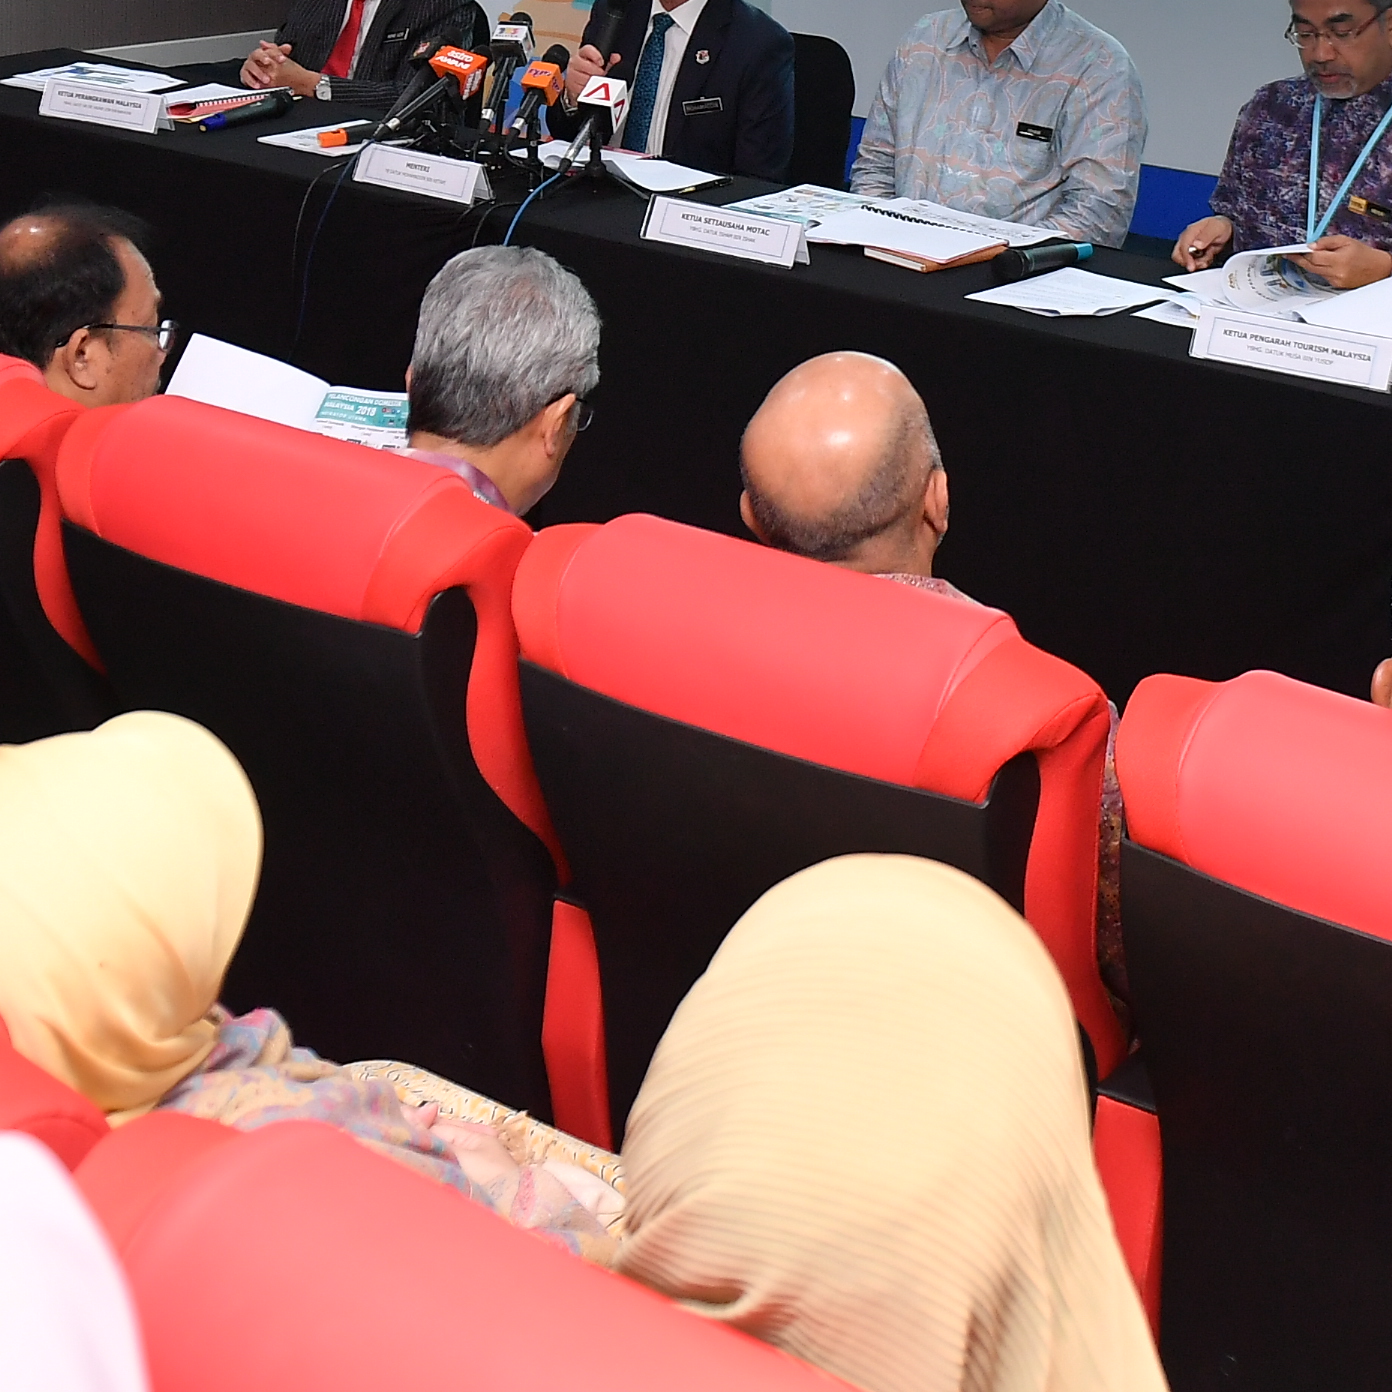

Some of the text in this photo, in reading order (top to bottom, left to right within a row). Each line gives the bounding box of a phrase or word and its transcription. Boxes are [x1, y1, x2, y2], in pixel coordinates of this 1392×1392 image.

[447, 50, 474, 62] astro
[681, 213, 771, 236] KETUA SETIAUSAHA MOTAC
[1223, 329, 1372, 362] KETUA PENGARAH TOURISM MALAYSIA
[355, 405, 377, 417] 2018
